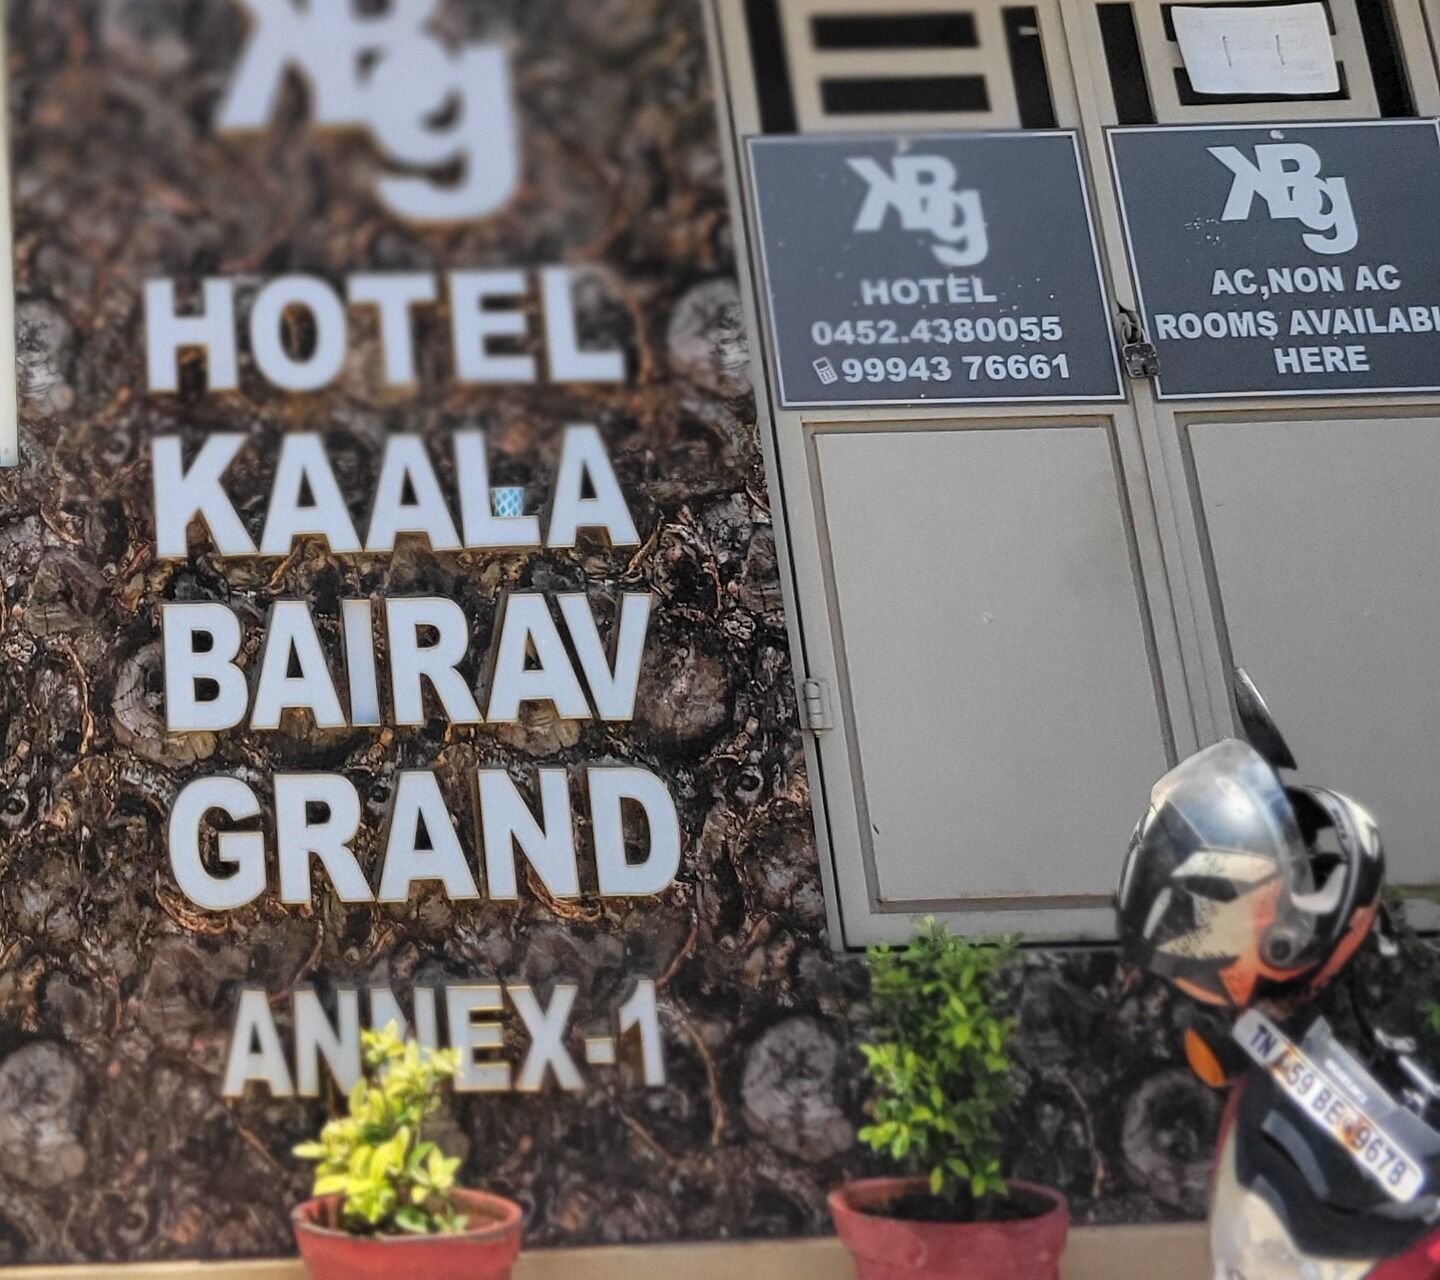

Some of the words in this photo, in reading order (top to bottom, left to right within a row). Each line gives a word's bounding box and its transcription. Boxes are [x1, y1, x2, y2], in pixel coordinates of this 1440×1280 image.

[861, 276, 998, 305] HOTEL
[1355, 263, 1402, 292] AC
[143, 264, 627, 394] HOTEL
[810, 316, 1064, 346] 0452.4380055
[1154, 308, 1278, 340] ROOMS
[840, 356, 953, 384] 99943
[961, 352, 1071, 382] 76661
[1273, 344, 1370, 375] HERE
[151, 422, 643, 559] KAALA
[160, 591, 654, 733] BAIRAV
[167, 765, 682, 912] GRAND
[1250, 1023, 1279, 1060] TN
